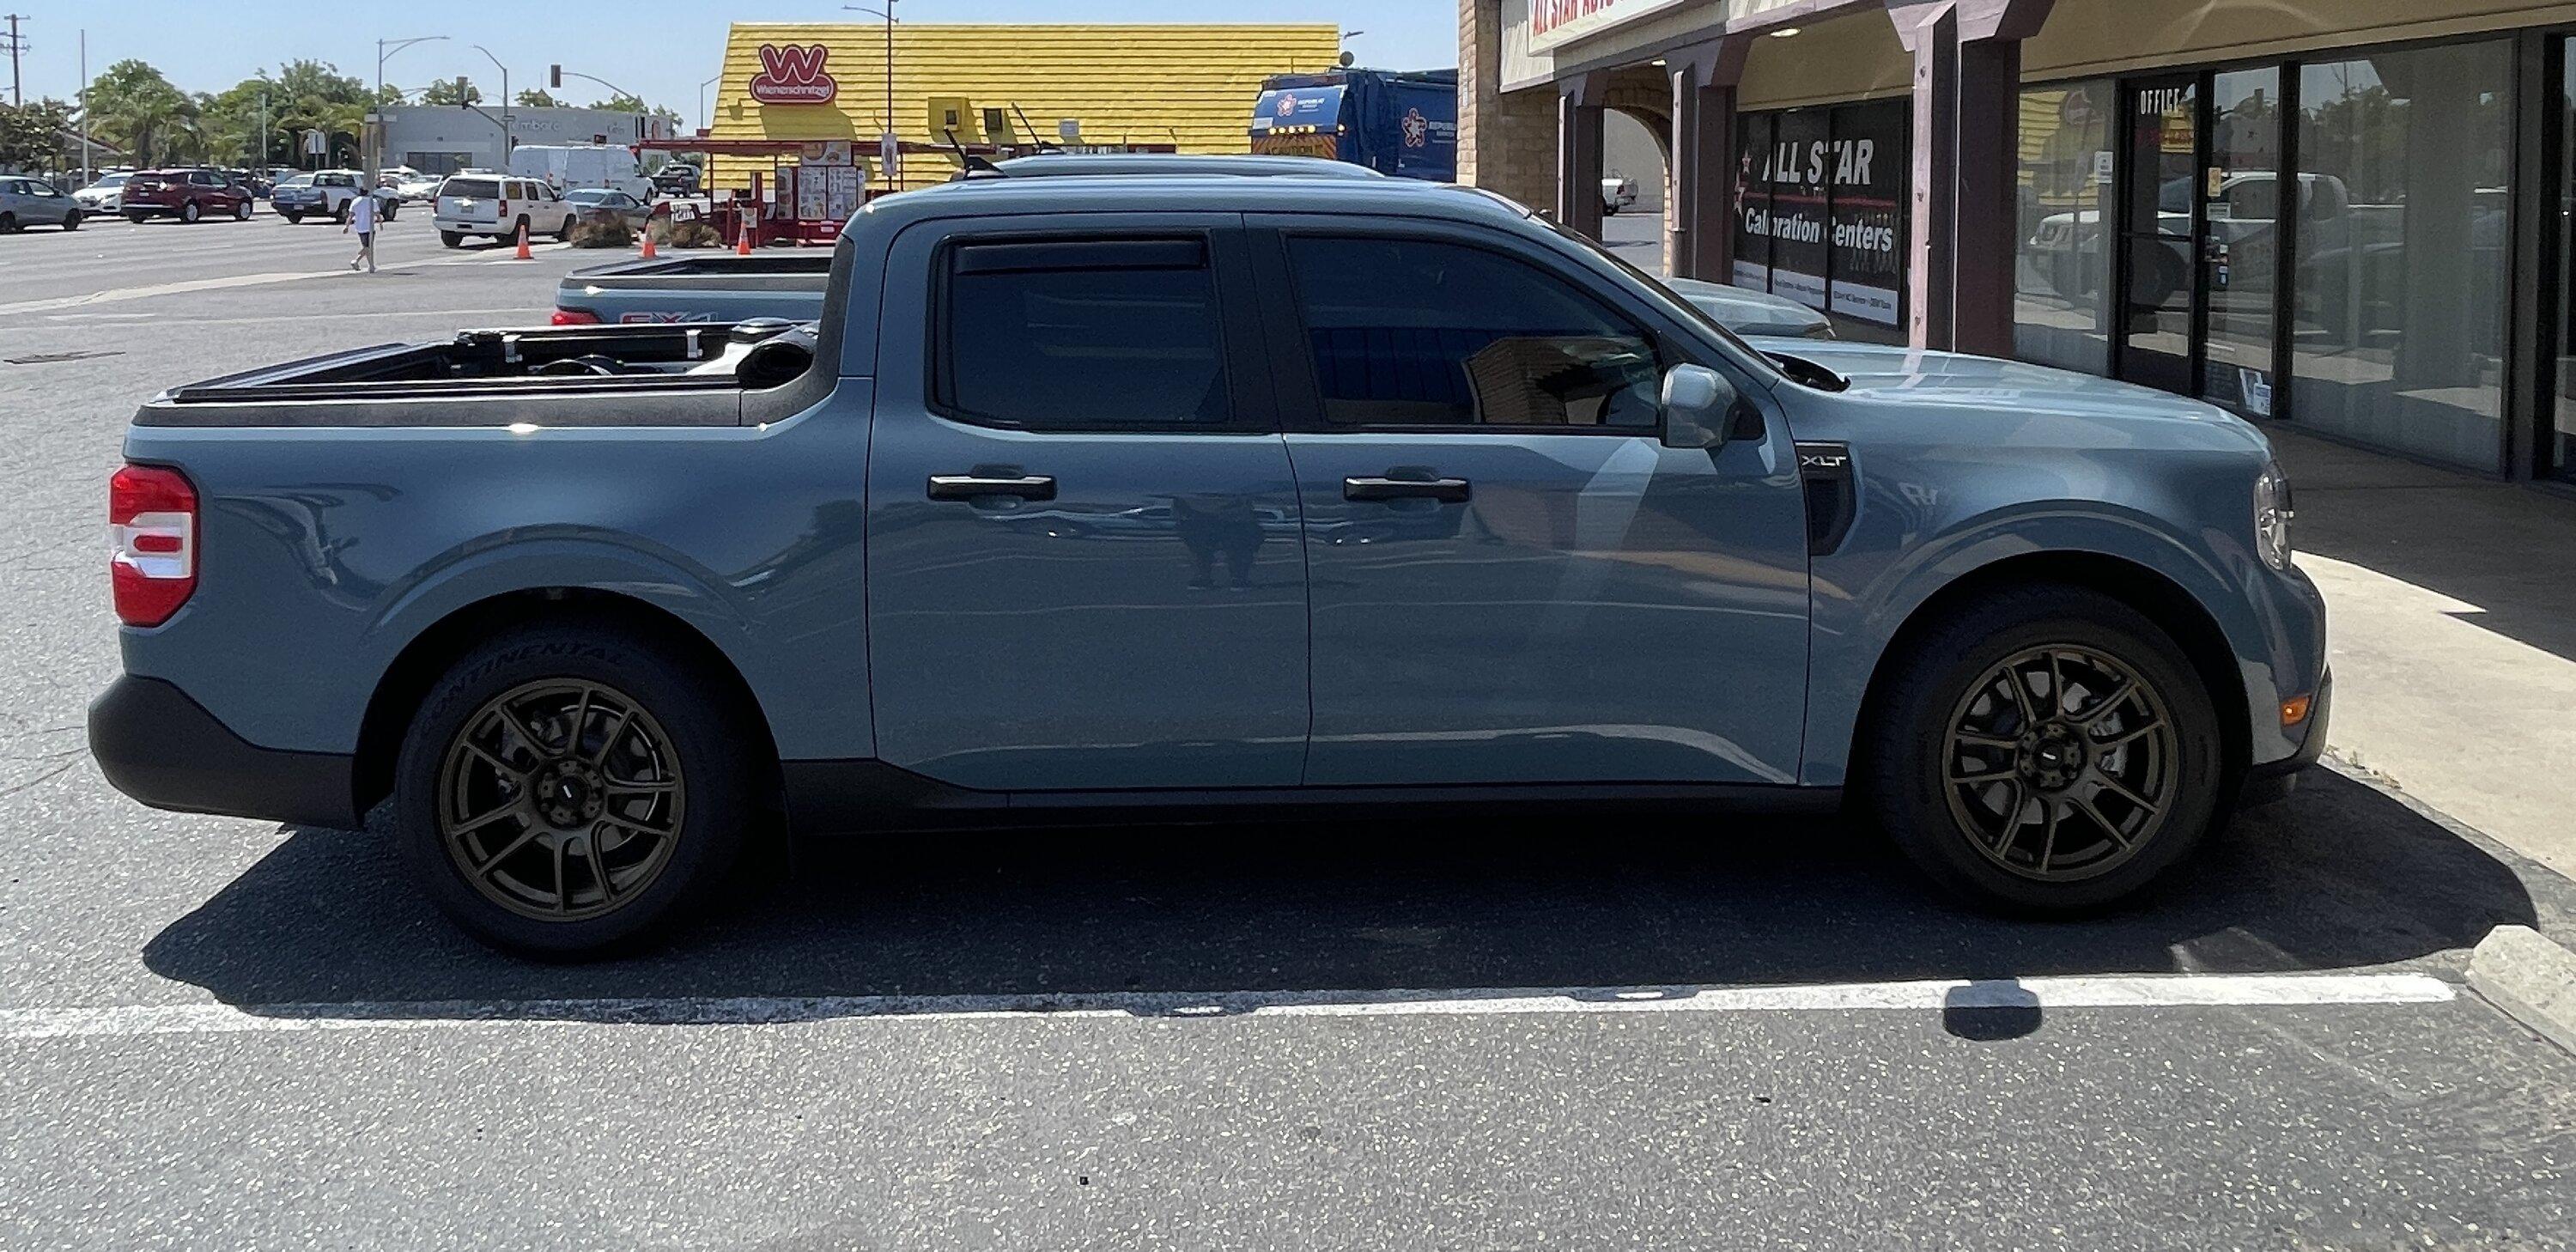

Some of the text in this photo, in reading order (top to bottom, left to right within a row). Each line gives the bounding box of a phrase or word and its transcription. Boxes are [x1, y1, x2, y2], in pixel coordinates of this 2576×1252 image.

[760, 46, 826, 84] W
[756, 84, 830, 97] Wienerschnitzel
[1801, 455, 1847, 467] XLT
